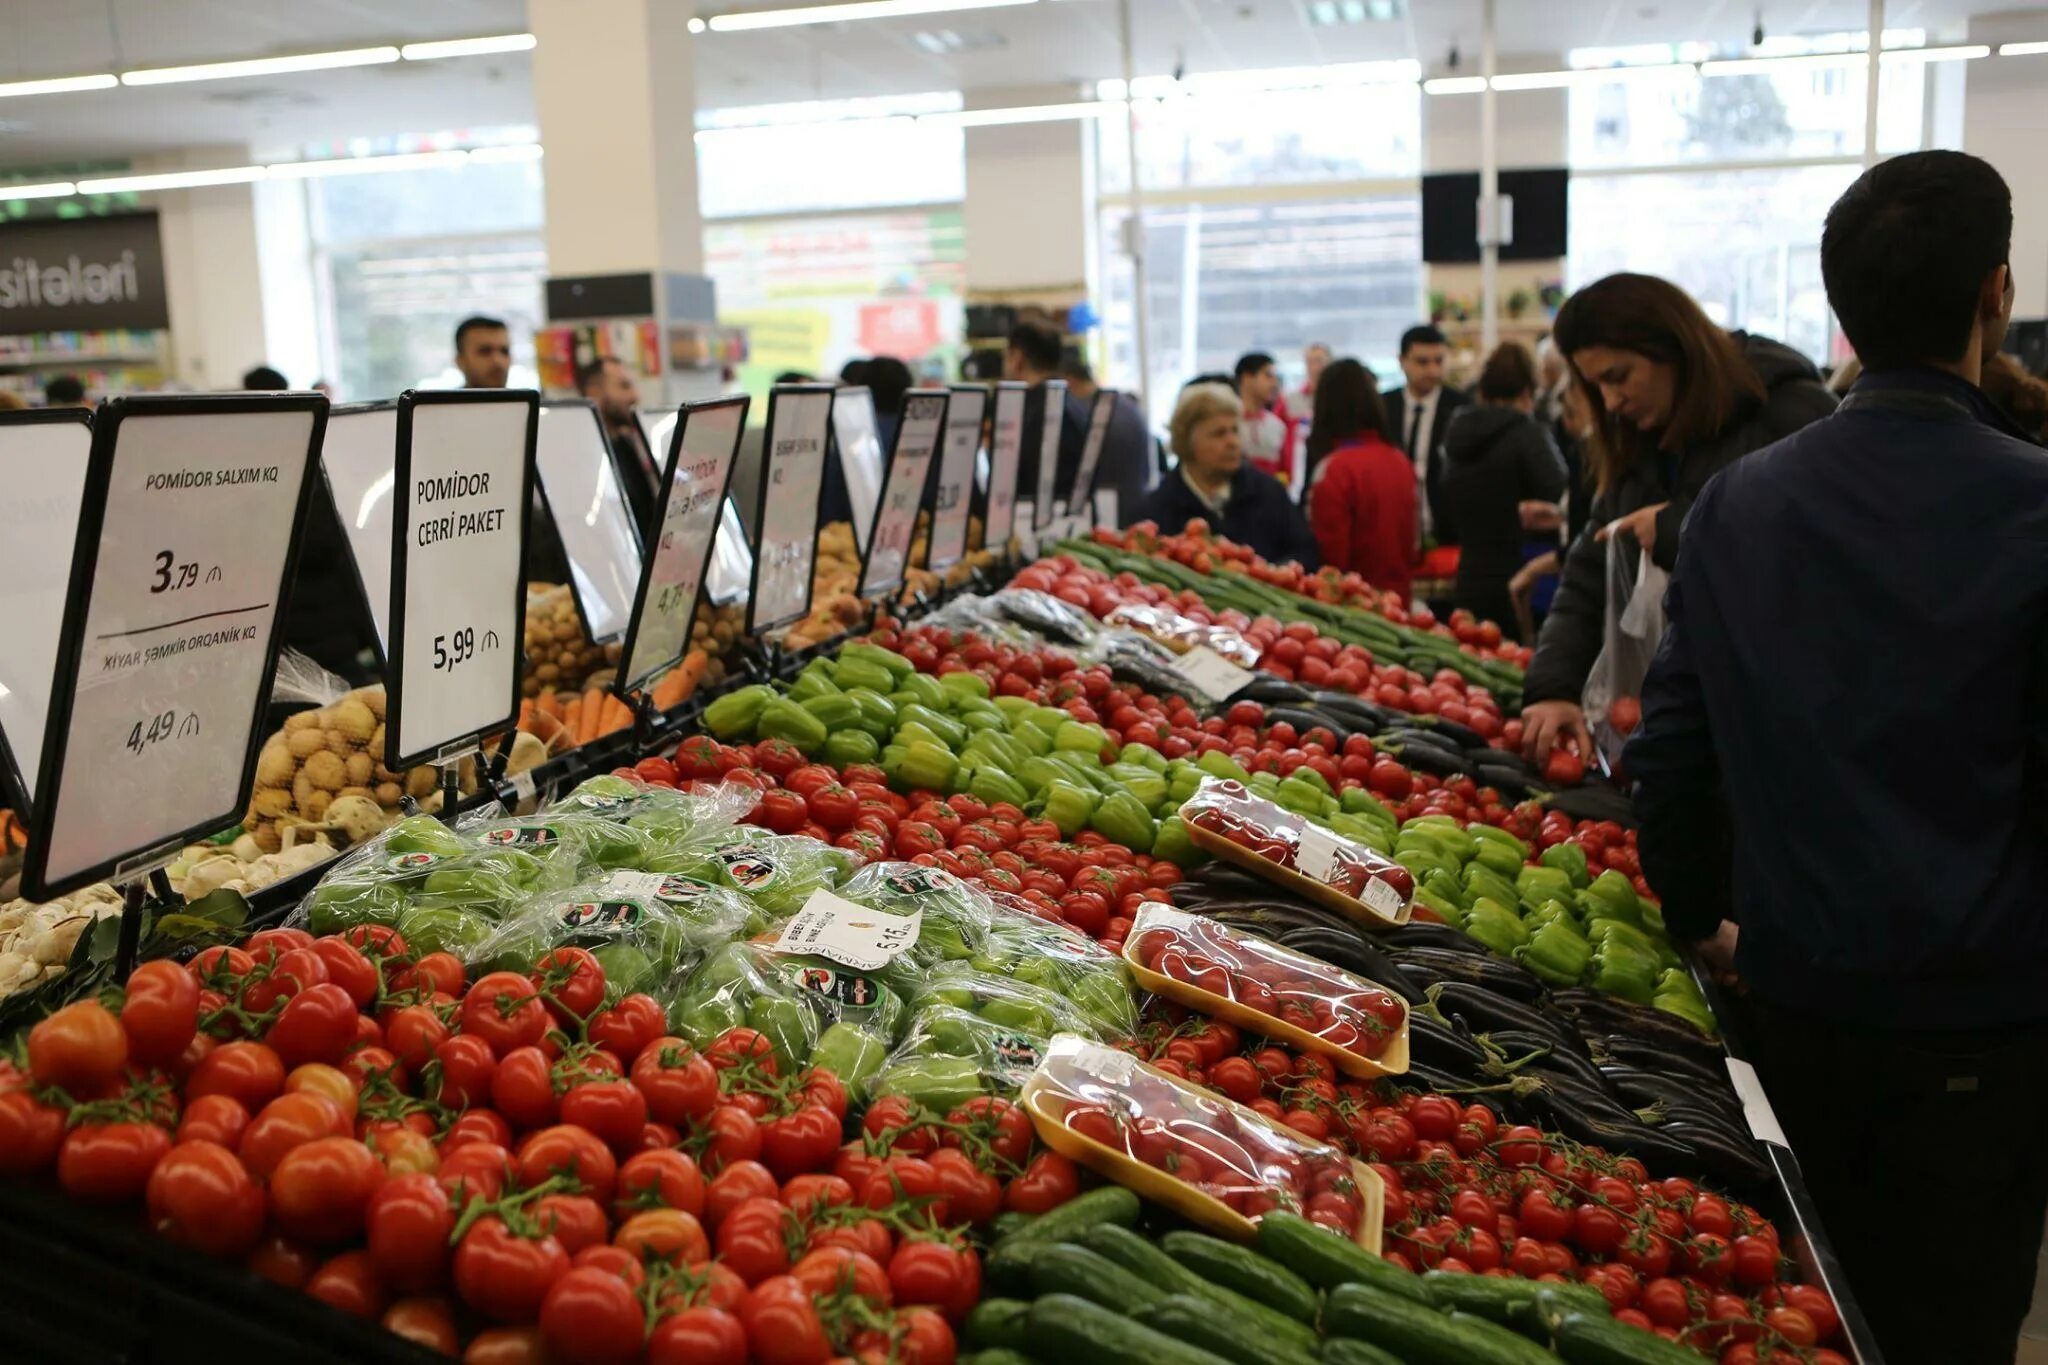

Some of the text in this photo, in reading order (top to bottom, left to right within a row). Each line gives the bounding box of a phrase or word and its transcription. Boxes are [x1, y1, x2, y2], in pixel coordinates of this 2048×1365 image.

[146, 466, 279, 491] POMİDOR SALXIM KQ
[418, 470, 490, 504] POMİDOR
[418, 508, 505, 547] CERRİ PAKET
[150, 550, 199, 593] 3.79
[143, 637, 185, 667] ŞƏMKİR
[188, 626, 240, 647] ORQANİK
[242, 626, 257, 640] KQ
[433, 627, 474, 672] 5,99
[126, 710, 175, 756] 4,49
